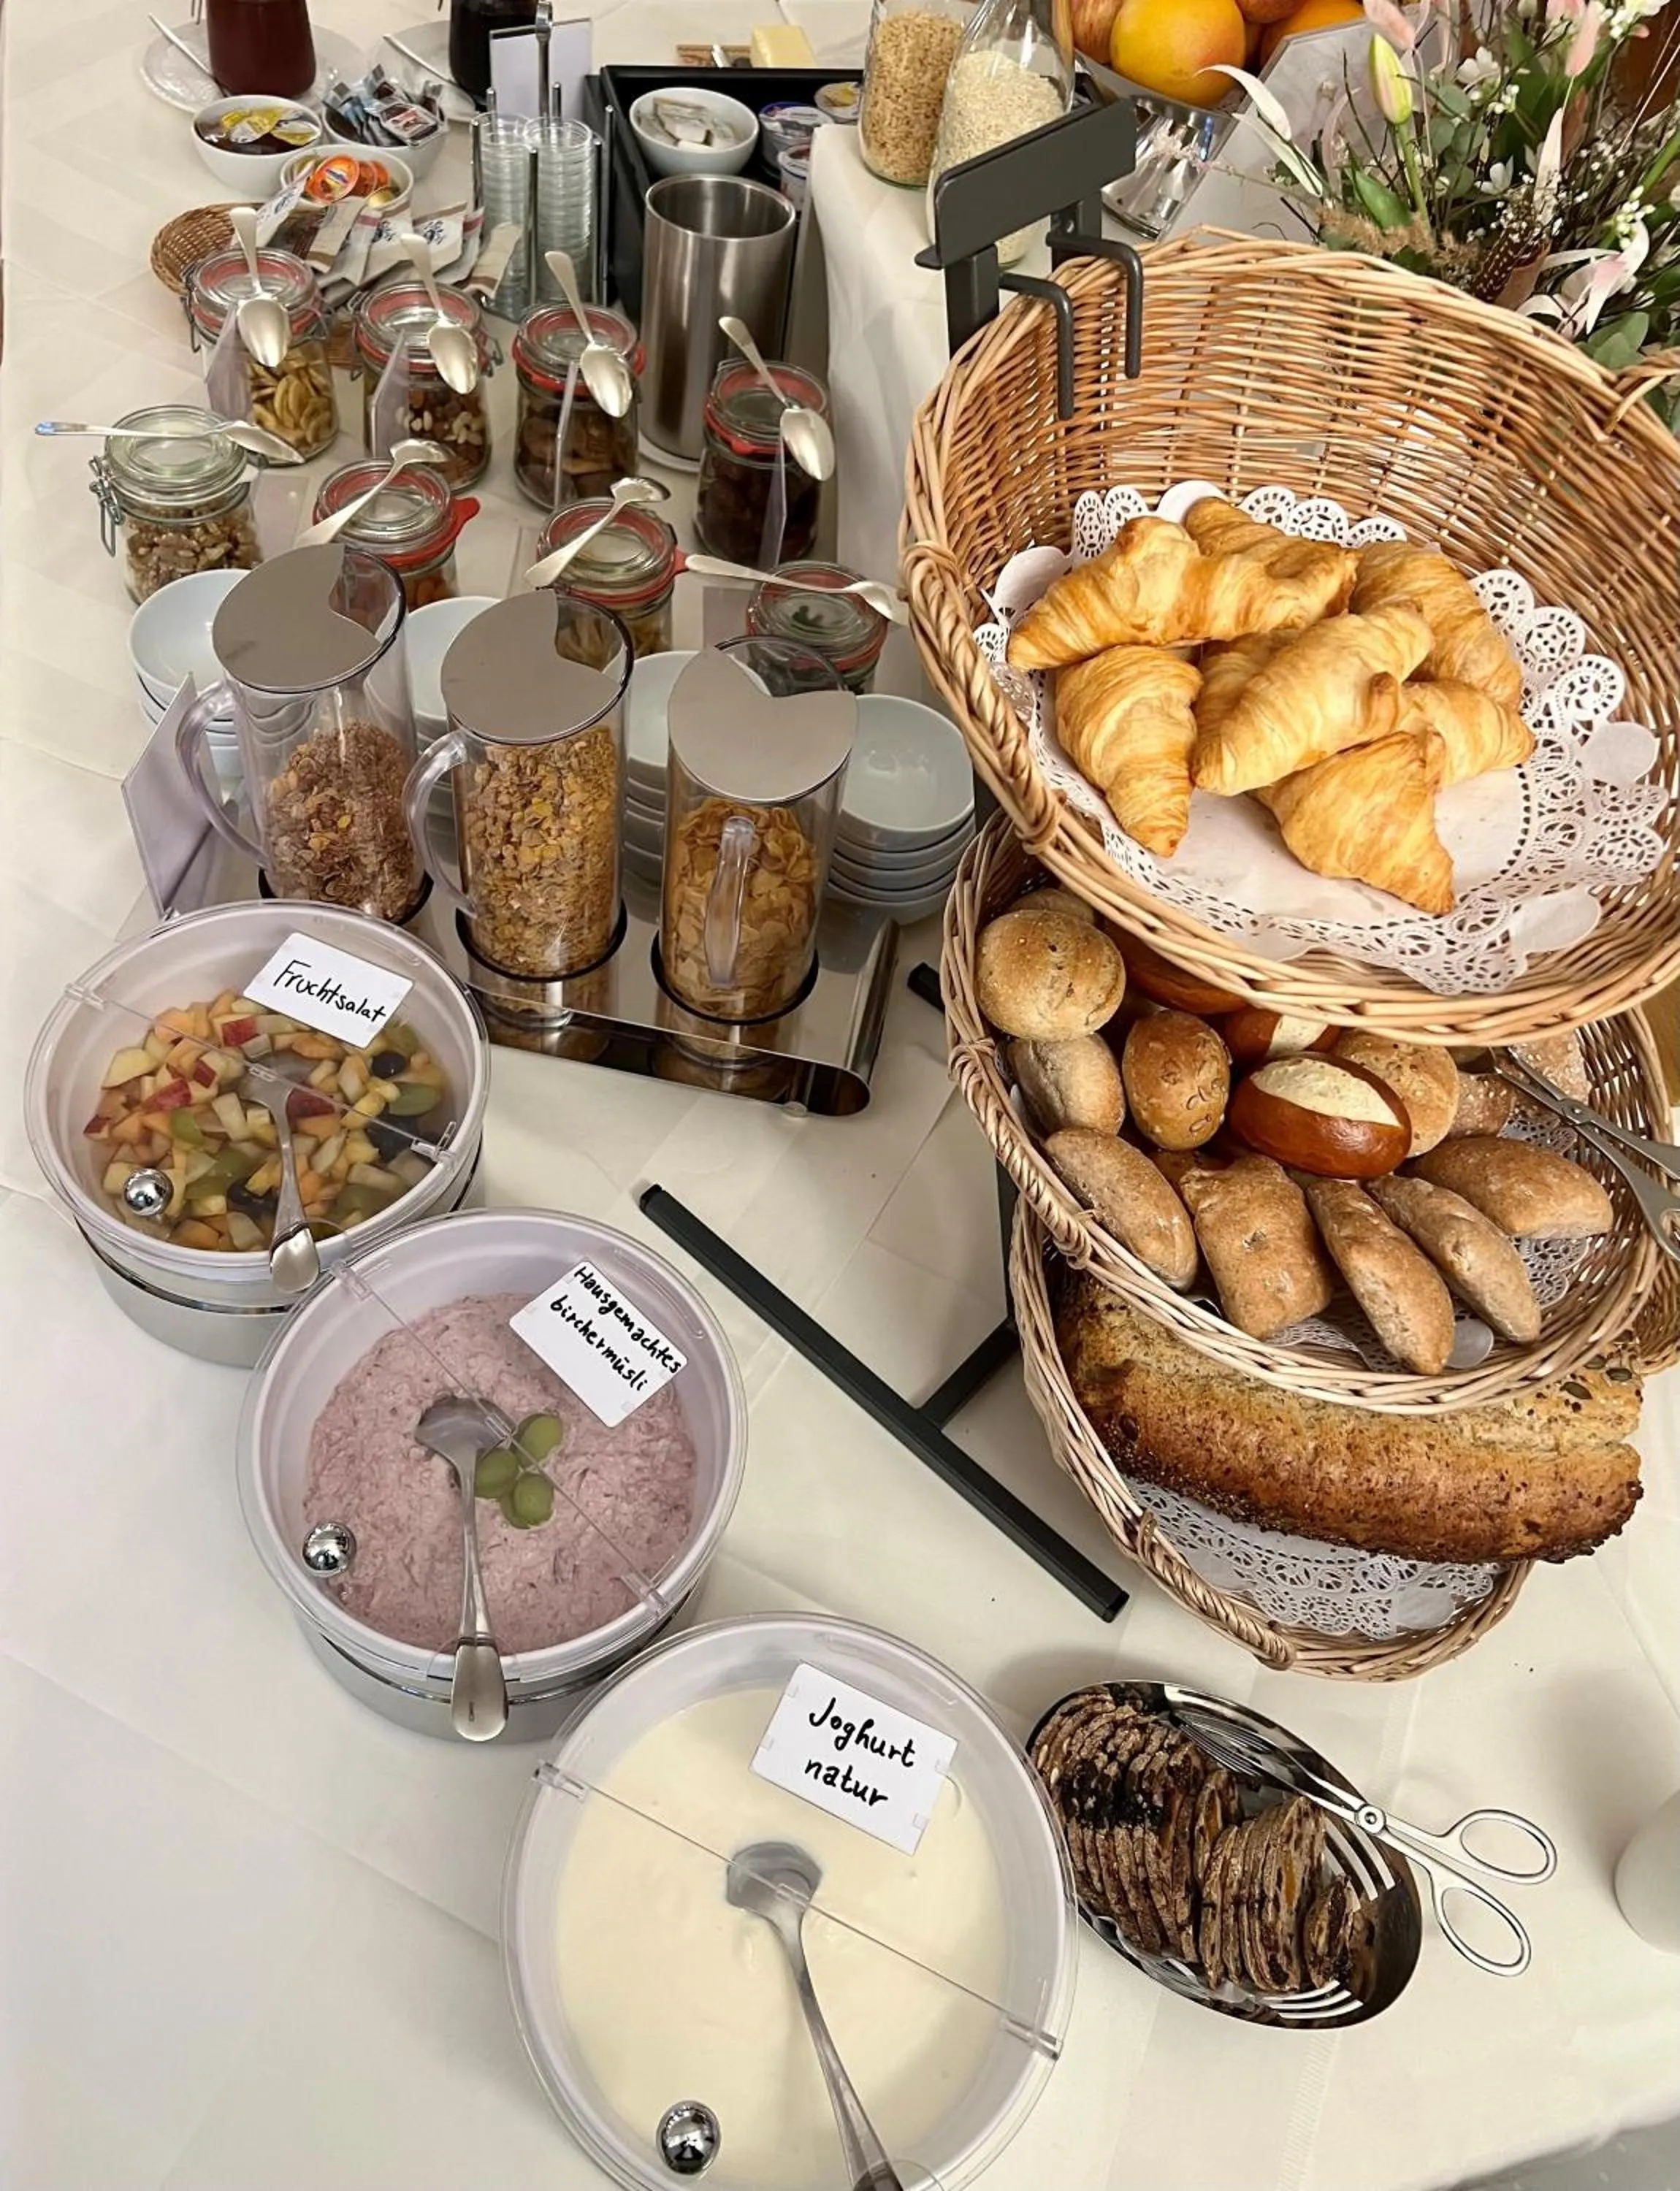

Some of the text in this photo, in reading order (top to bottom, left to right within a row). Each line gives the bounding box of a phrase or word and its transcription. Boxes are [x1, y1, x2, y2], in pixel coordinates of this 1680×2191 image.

[273, 959, 386, 1022] Fruchtsalat
[550, 1294, 648, 1391] birchermüsli
[573, 1266, 681, 1374] Hausgemachtes
[809, 1697, 916, 1767] Joghurt
[804, 1759, 888, 1806] natur
